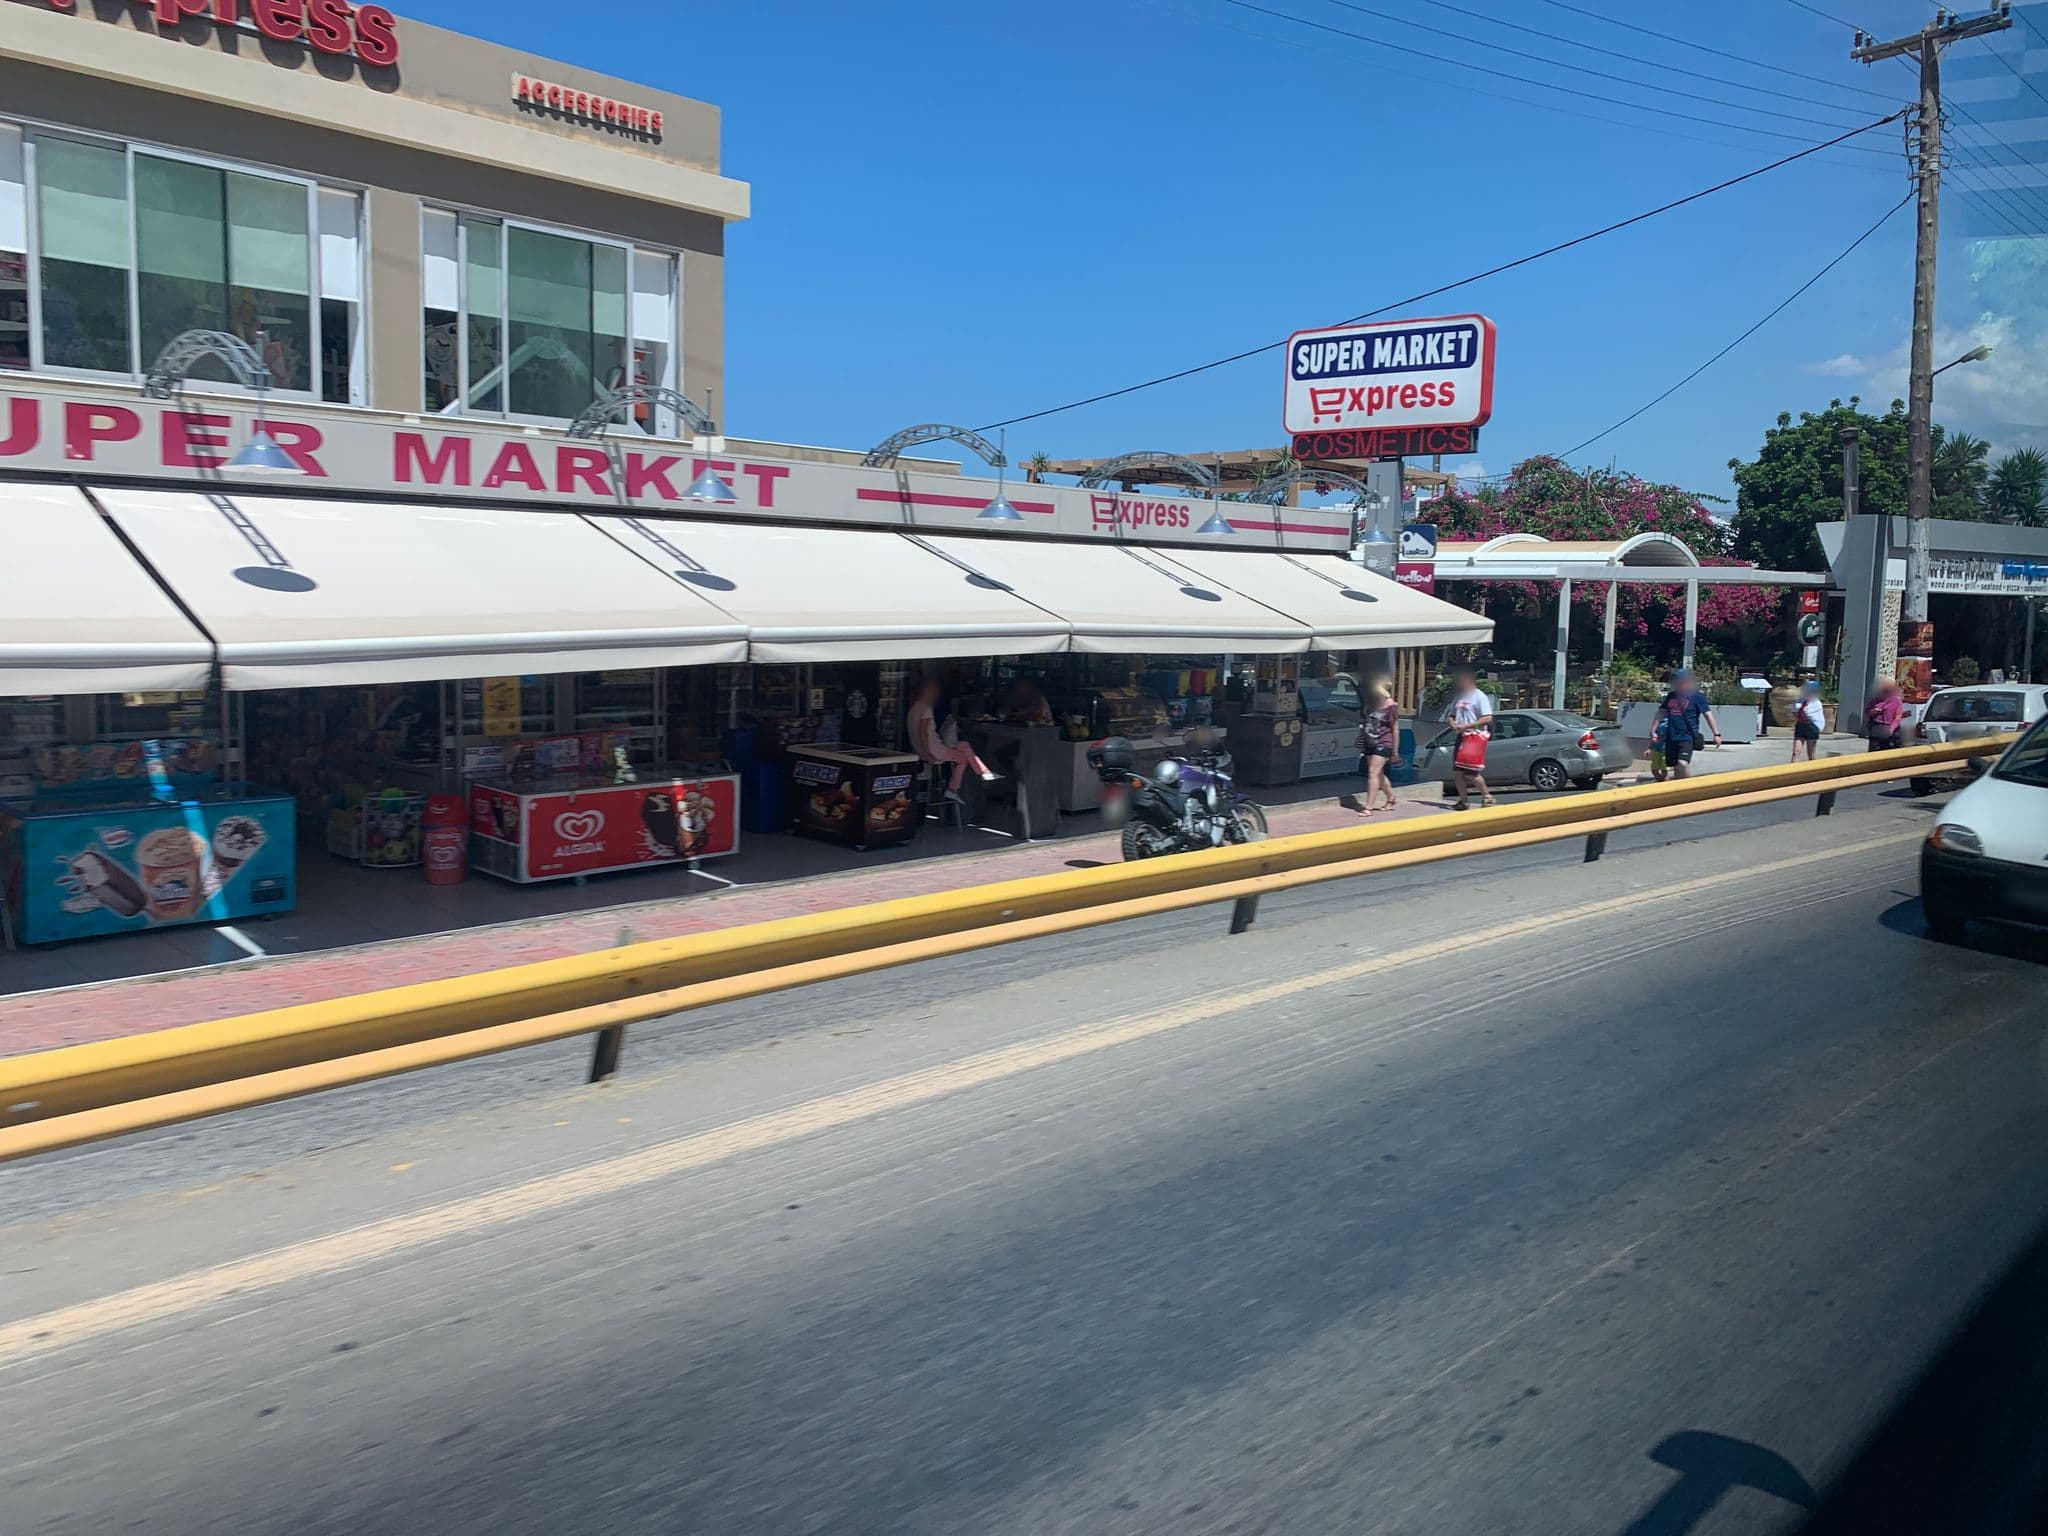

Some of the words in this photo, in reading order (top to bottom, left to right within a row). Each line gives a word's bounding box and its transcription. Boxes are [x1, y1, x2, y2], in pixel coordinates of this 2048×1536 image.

[517, 77, 662, 130] ACCESSORIES
[1296, 339, 1367, 375] SUPER
[1373, 330, 1472, 369] MARKET
[1292, 426, 1472, 459] COSMETICS
